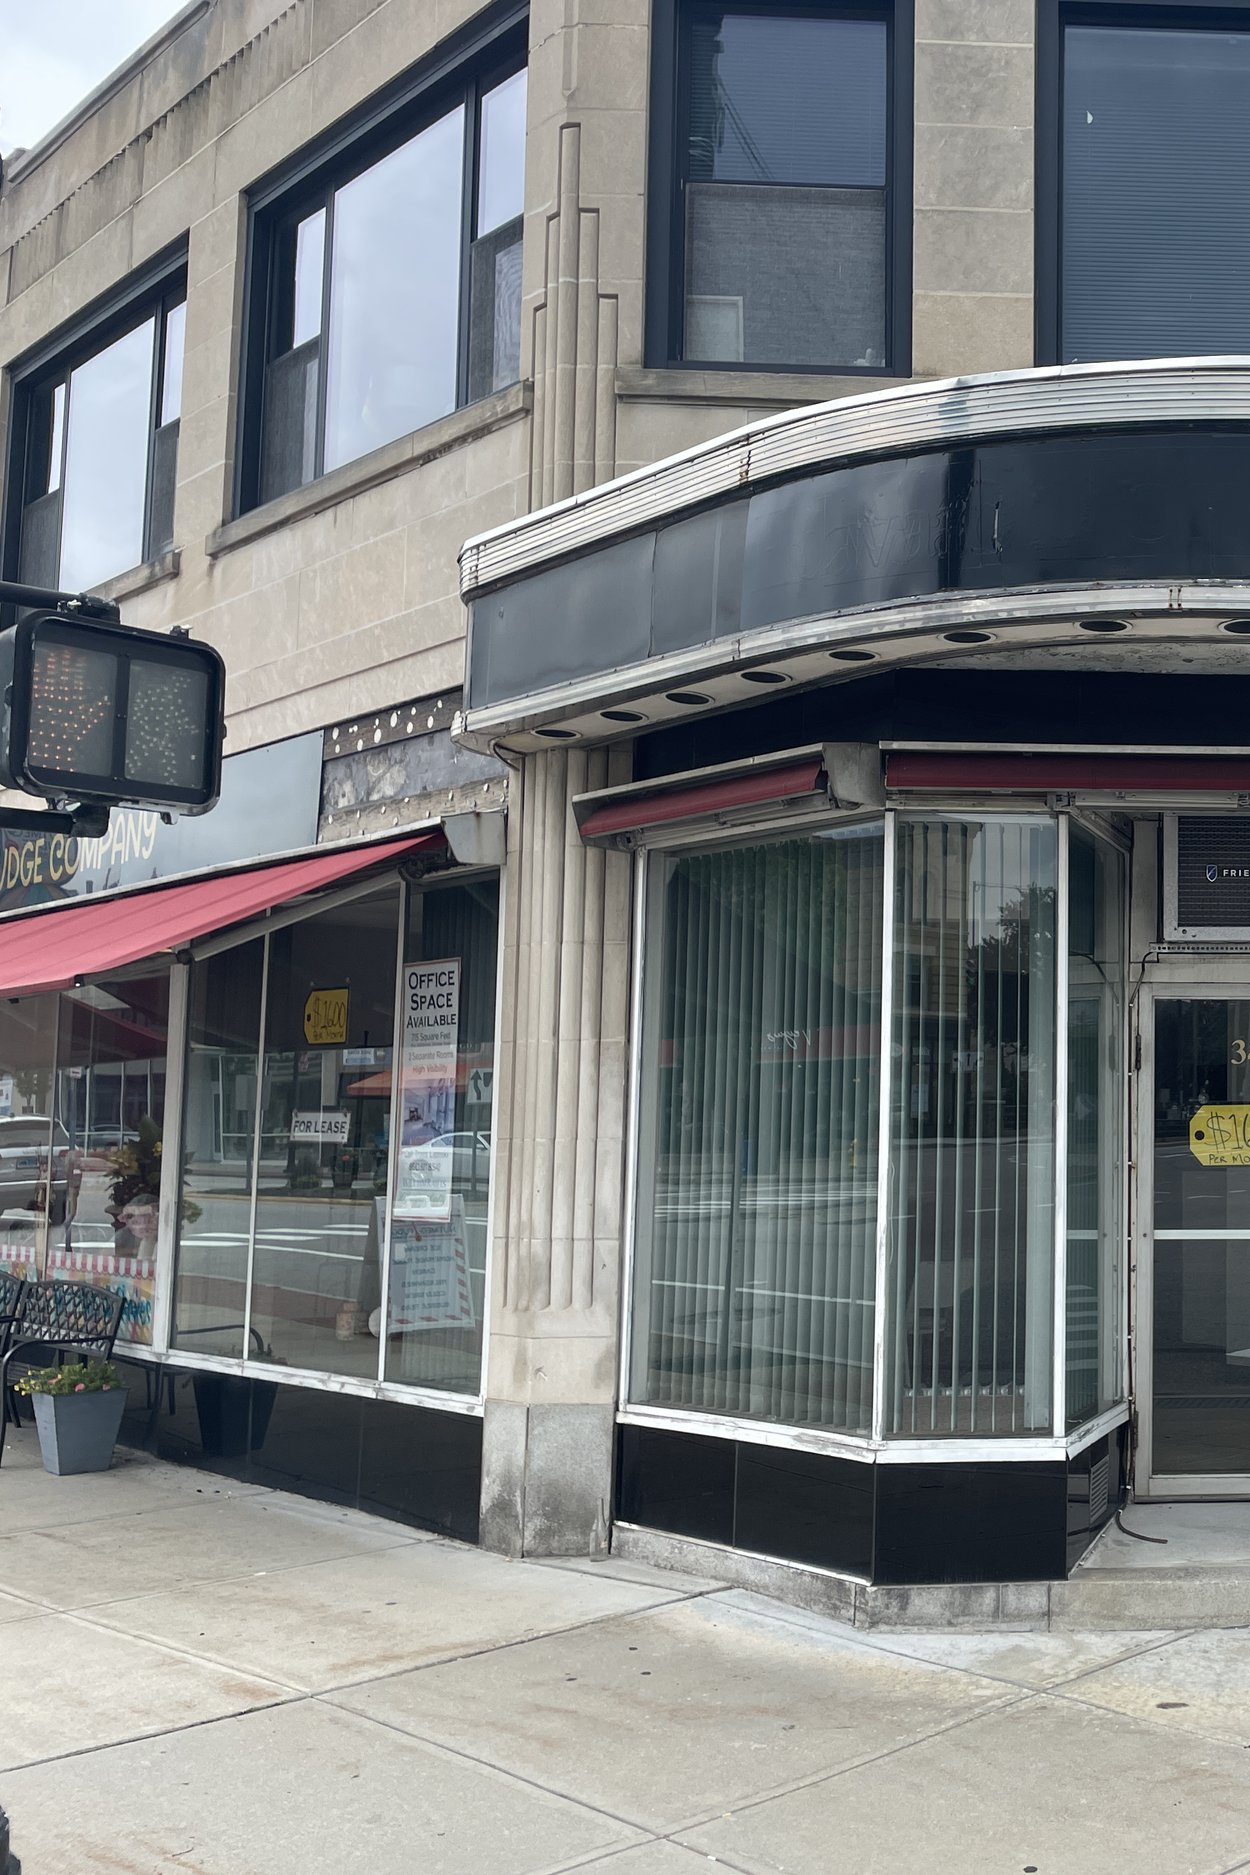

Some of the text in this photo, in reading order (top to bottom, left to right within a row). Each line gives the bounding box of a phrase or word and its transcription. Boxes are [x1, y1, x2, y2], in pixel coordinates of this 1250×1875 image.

[50, 811, 158, 881] COMPANY
[408, 971, 455, 990] OFFICE
[410, 993, 453, 1011] SPACE
[313, 996, 346, 1030] $1600
[406, 1013, 456, 1029] AVAILABLE
[294, 1120, 347, 1134] FOR LEASE
